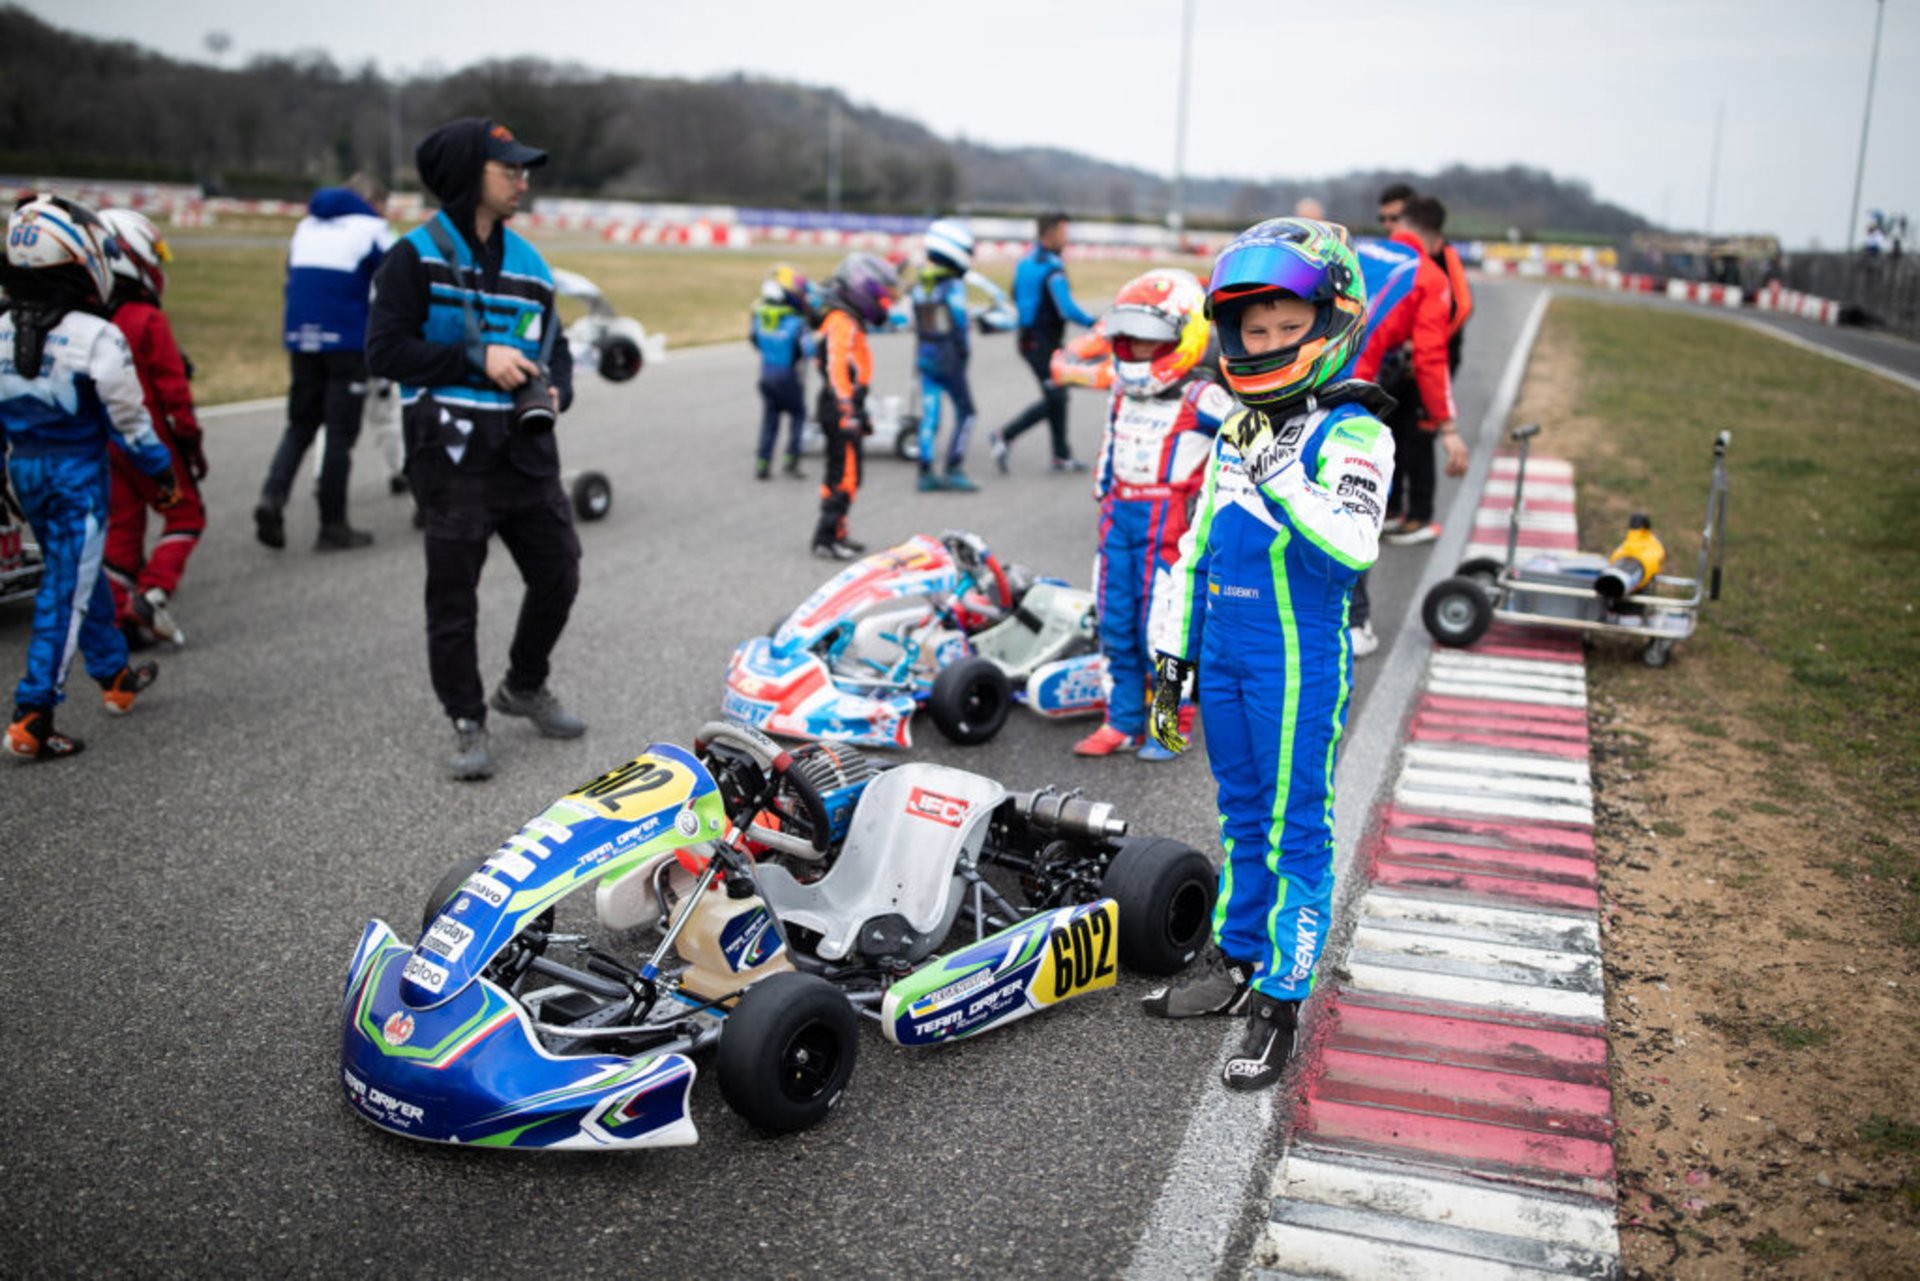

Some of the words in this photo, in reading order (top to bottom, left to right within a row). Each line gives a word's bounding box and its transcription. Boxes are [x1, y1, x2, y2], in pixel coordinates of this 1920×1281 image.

[567, 761, 674, 813] 02
[616, 816, 660, 846] DRIVER
[1051, 908, 1115, 999] 602
[914, 1010, 963, 1037] TEAM
[969, 979, 1024, 1016] DRIVER
[368, 1087, 424, 1125] DRIVER
